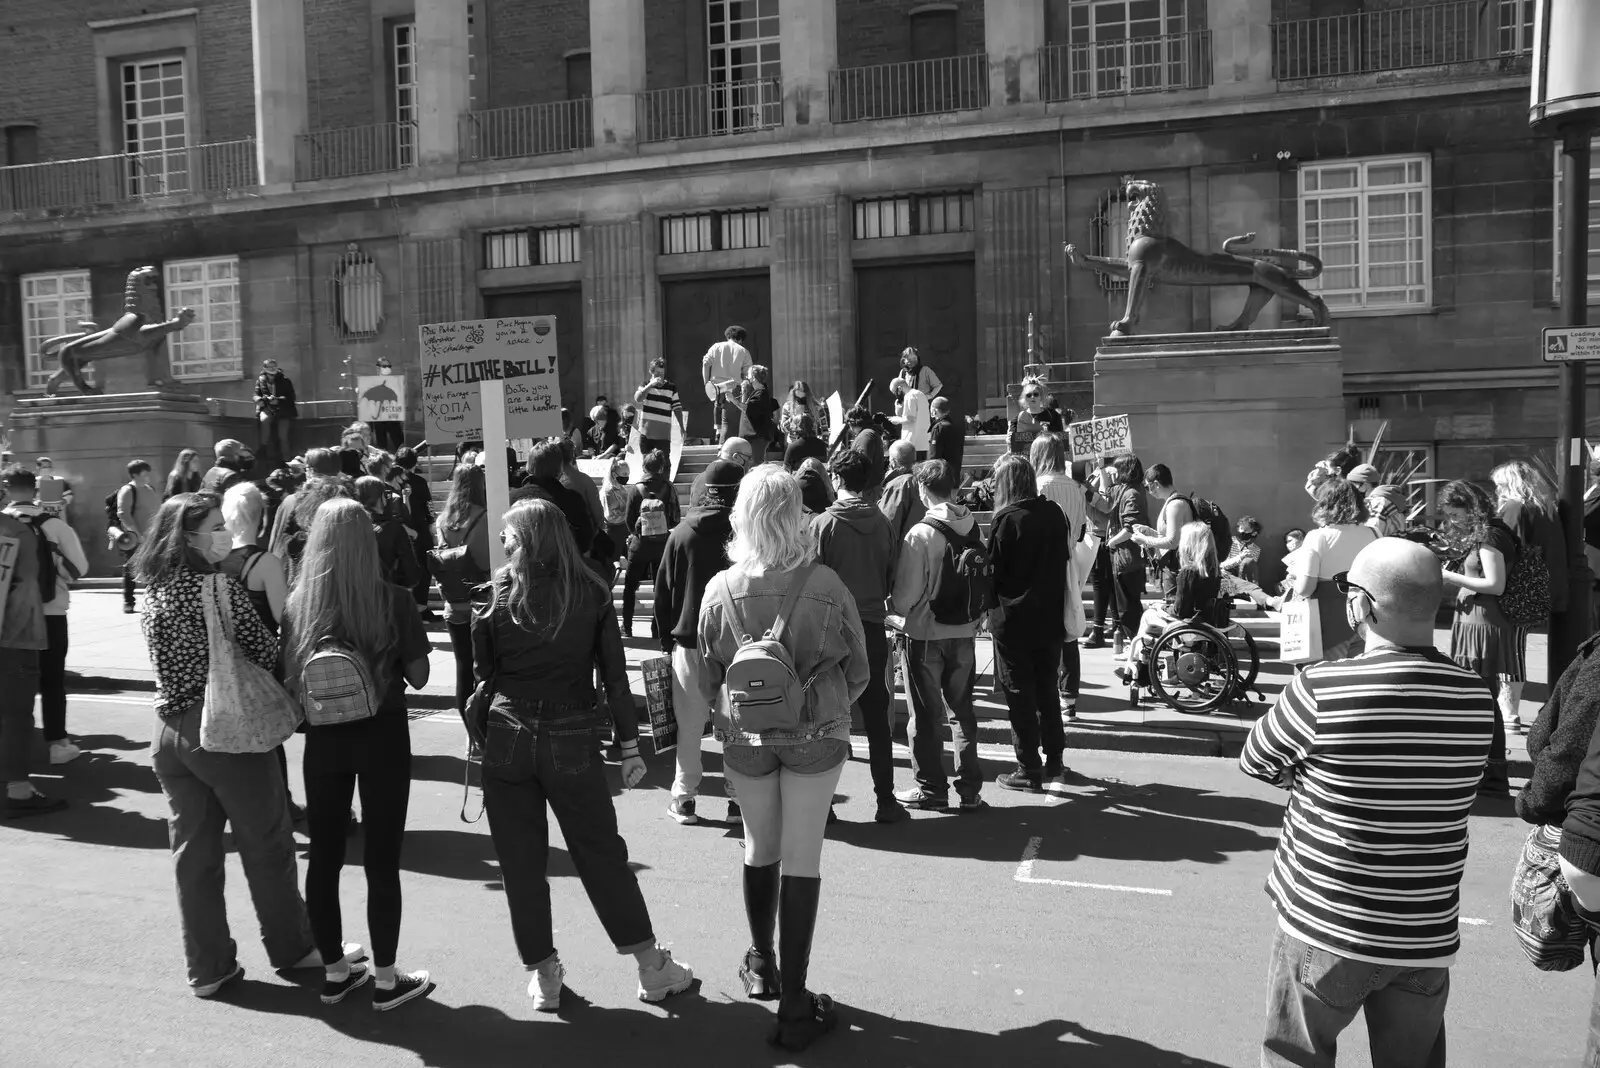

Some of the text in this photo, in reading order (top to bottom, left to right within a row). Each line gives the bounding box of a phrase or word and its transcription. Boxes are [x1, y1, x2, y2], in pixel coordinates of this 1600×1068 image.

[531, 384, 549, 395] you
[507, 396, 522, 404] are
[1072, 416, 1128, 434] THIS IS WHAT
[1074, 426, 1129, 446] DEMOCRACY
[1104, 438, 1125, 450] LIKE
